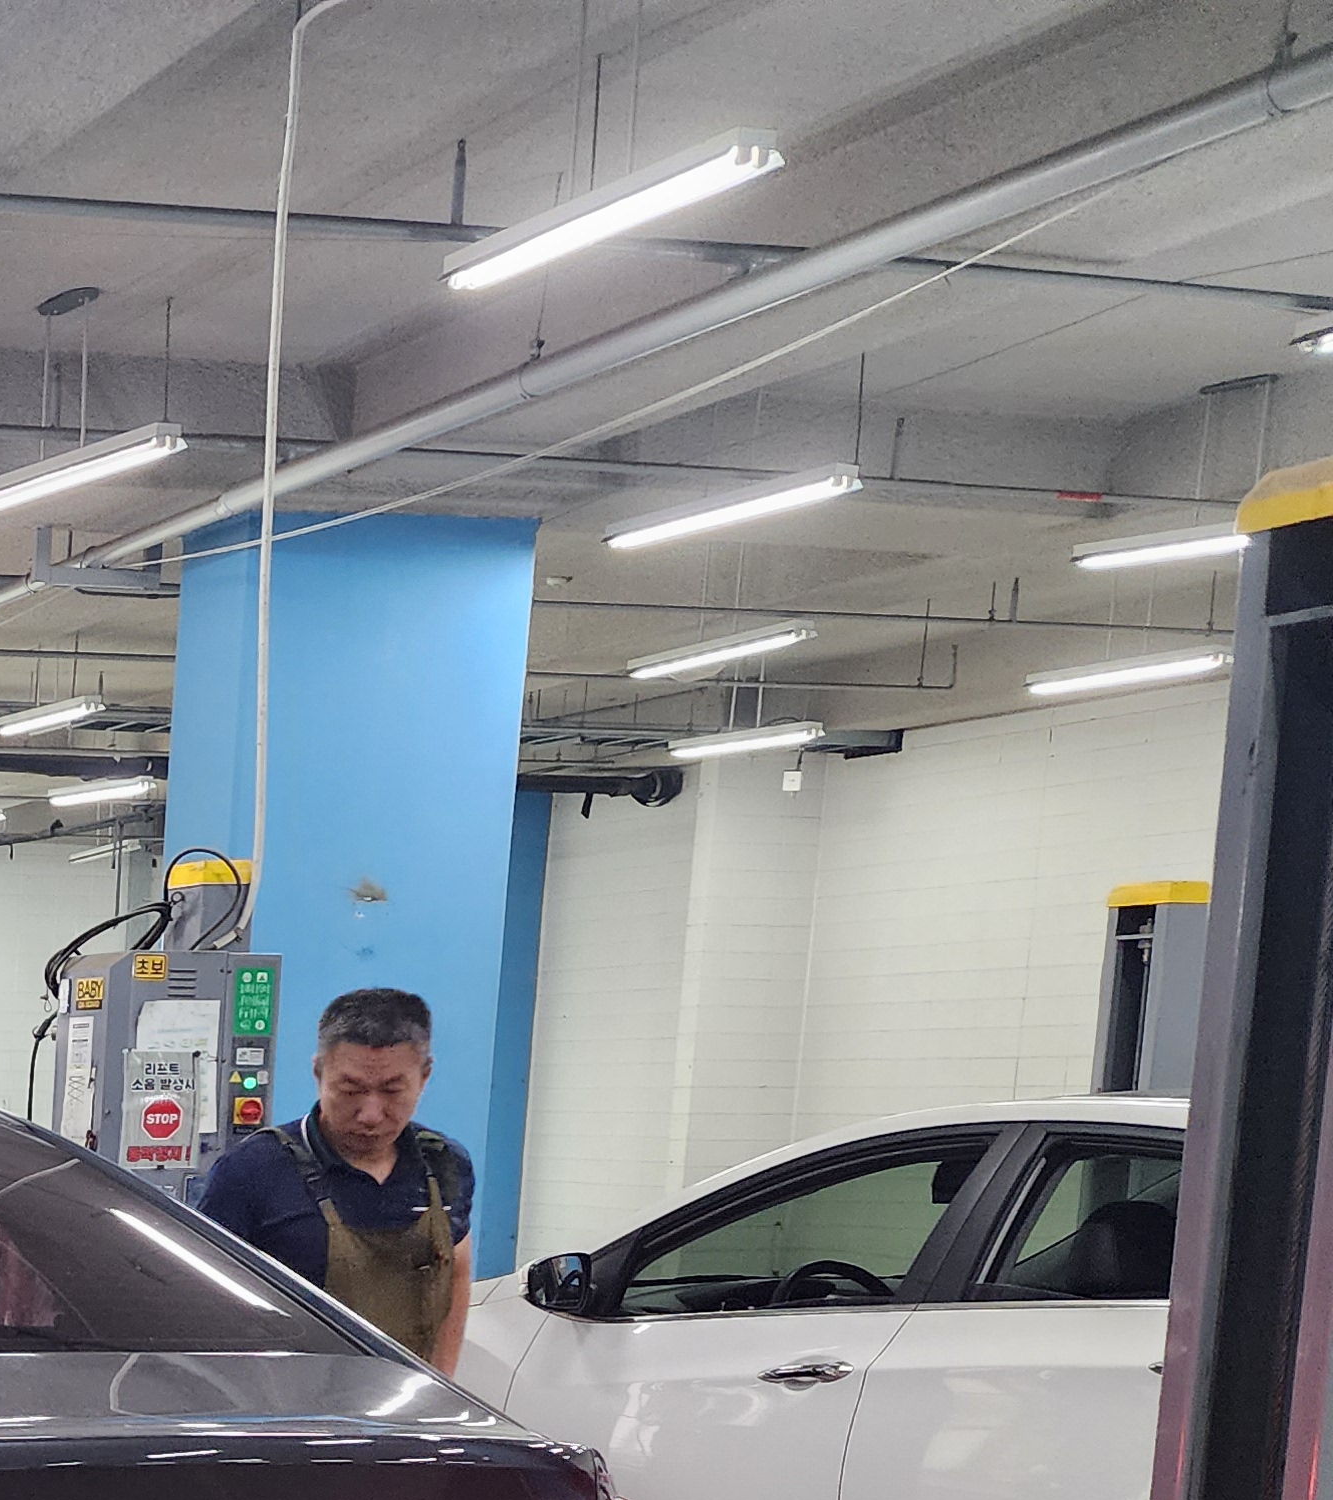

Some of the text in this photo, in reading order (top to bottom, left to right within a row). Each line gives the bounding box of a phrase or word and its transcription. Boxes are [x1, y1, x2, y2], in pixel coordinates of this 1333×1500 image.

[136, 959, 164, 975] 초보
[77, 980, 103, 999] BABY
[145, 1064, 180, 1075] 리프트
[132, 1078, 195, 1091] 소음 발생시
[146, 1113, 178, 1125] STOP
